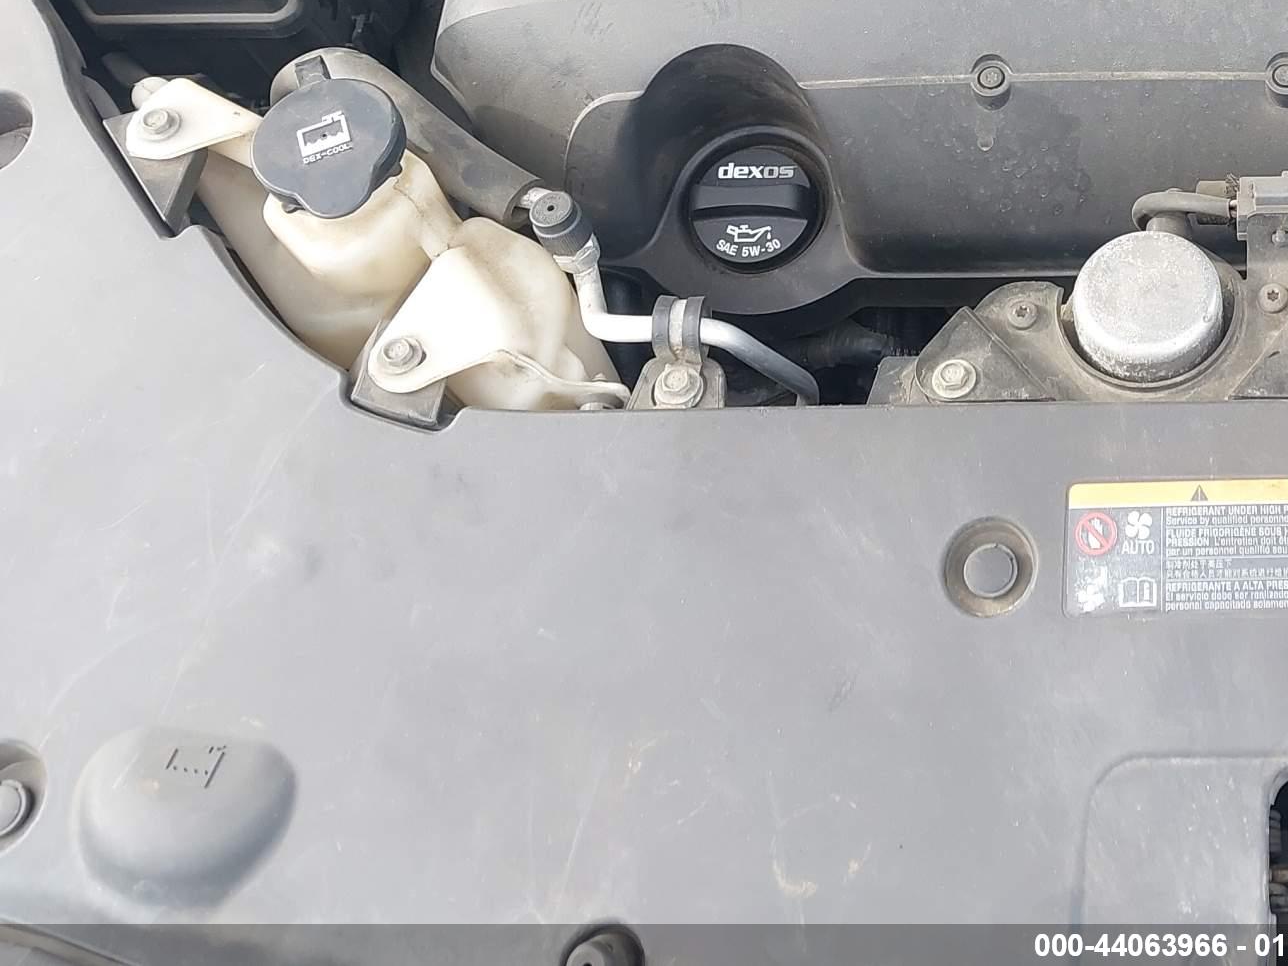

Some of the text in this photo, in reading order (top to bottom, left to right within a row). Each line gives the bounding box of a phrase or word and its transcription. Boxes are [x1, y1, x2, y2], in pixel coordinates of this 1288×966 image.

[718, 162, 797, 179] dexos
[716, 239, 782, 257] SAE 5W-30
[1166, 505, 1226, 516] REFRIGERANT
[1229, 505, 1257, 515] UNDER
[1260, 505, 1281, 514] HIGH
[1166, 516, 1197, 526] Service
[1200, 515, 1210, 526] by
[1212, 514, 1248, 525] qualified
[1166, 527, 1196, 538] FLUIDE
[1259, 526, 1281, 535] SOUS
[1261, 536, 1276, 546] doit
[1121, 539, 1155, 555] AUTO
[1166, 547, 1180, 557] par
[1183, 547, 1193, 556] un
[1196, 546, 1237, 556] personnel
[1166, 581, 1231, 592] REFRIGERANTE
[1234, 581, 1240, 591] A
[1243, 581, 1264, 590] ALTA
[1166, 592, 1174, 602] El
[1175, 591, 1208, 601] servicio
[1211, 591, 1232, 600] debe
[1234, 591, 1248, 600] ser
[1166, 601, 1203, 611] personal
